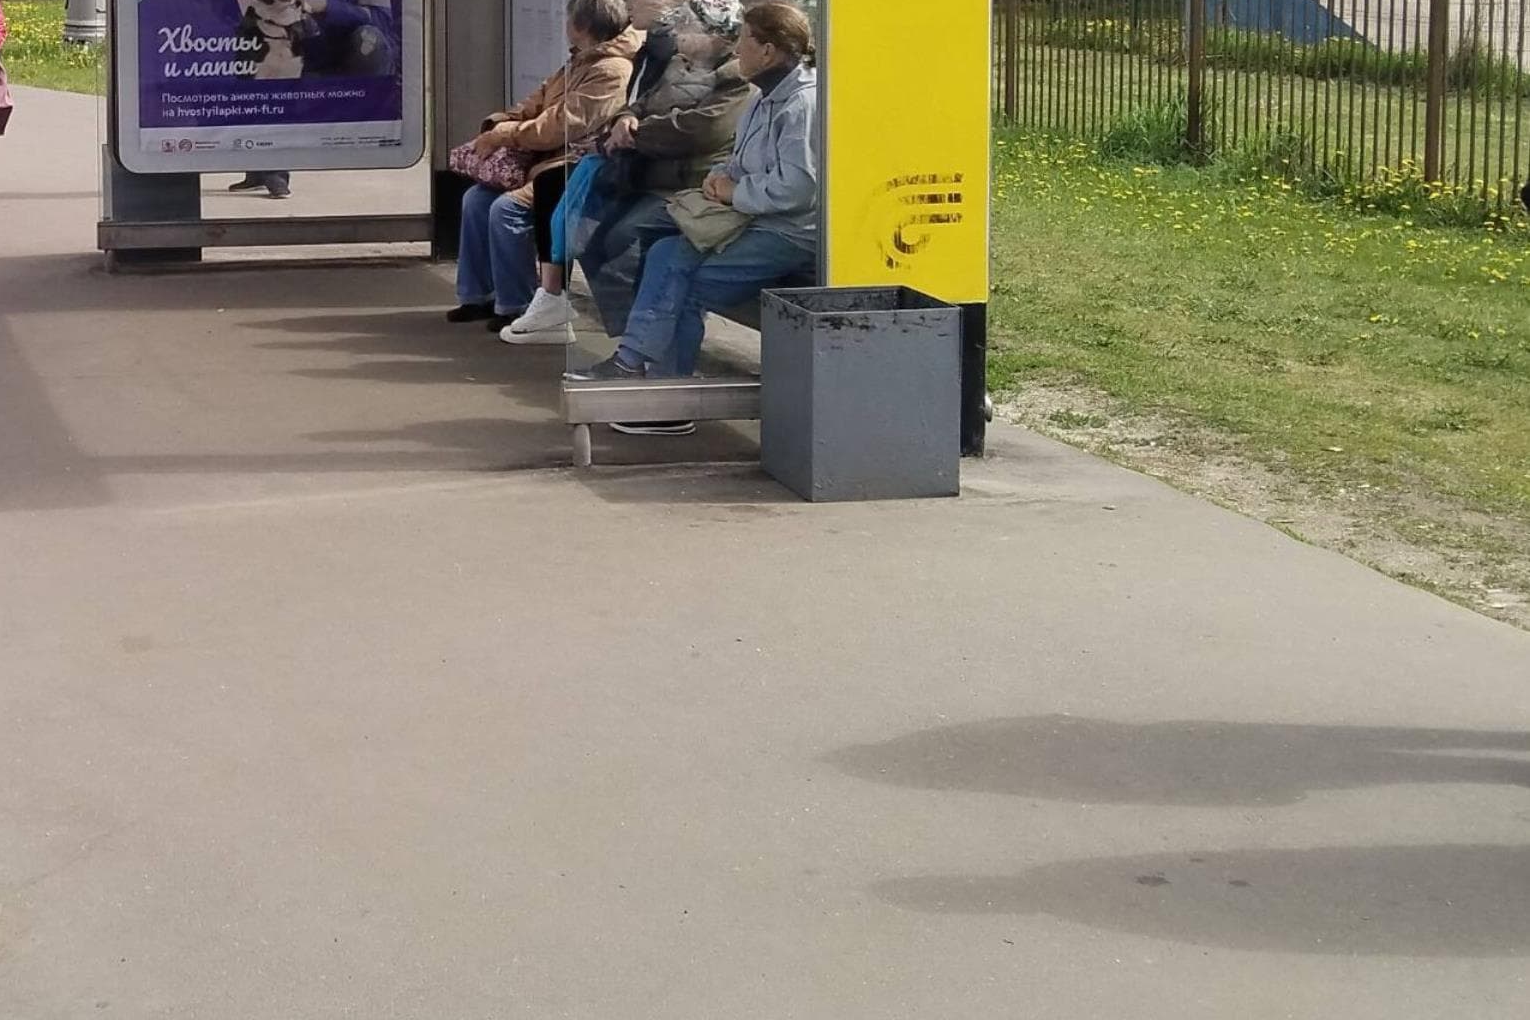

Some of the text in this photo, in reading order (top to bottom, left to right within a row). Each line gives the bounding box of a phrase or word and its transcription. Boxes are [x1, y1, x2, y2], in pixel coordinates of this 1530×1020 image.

[158, 24, 262, 54] Хвосты
[164, 59, 258, 78] и лапки
[161, 92, 228, 104] Посмотреть
[230, 92, 269, 103] анкеты
